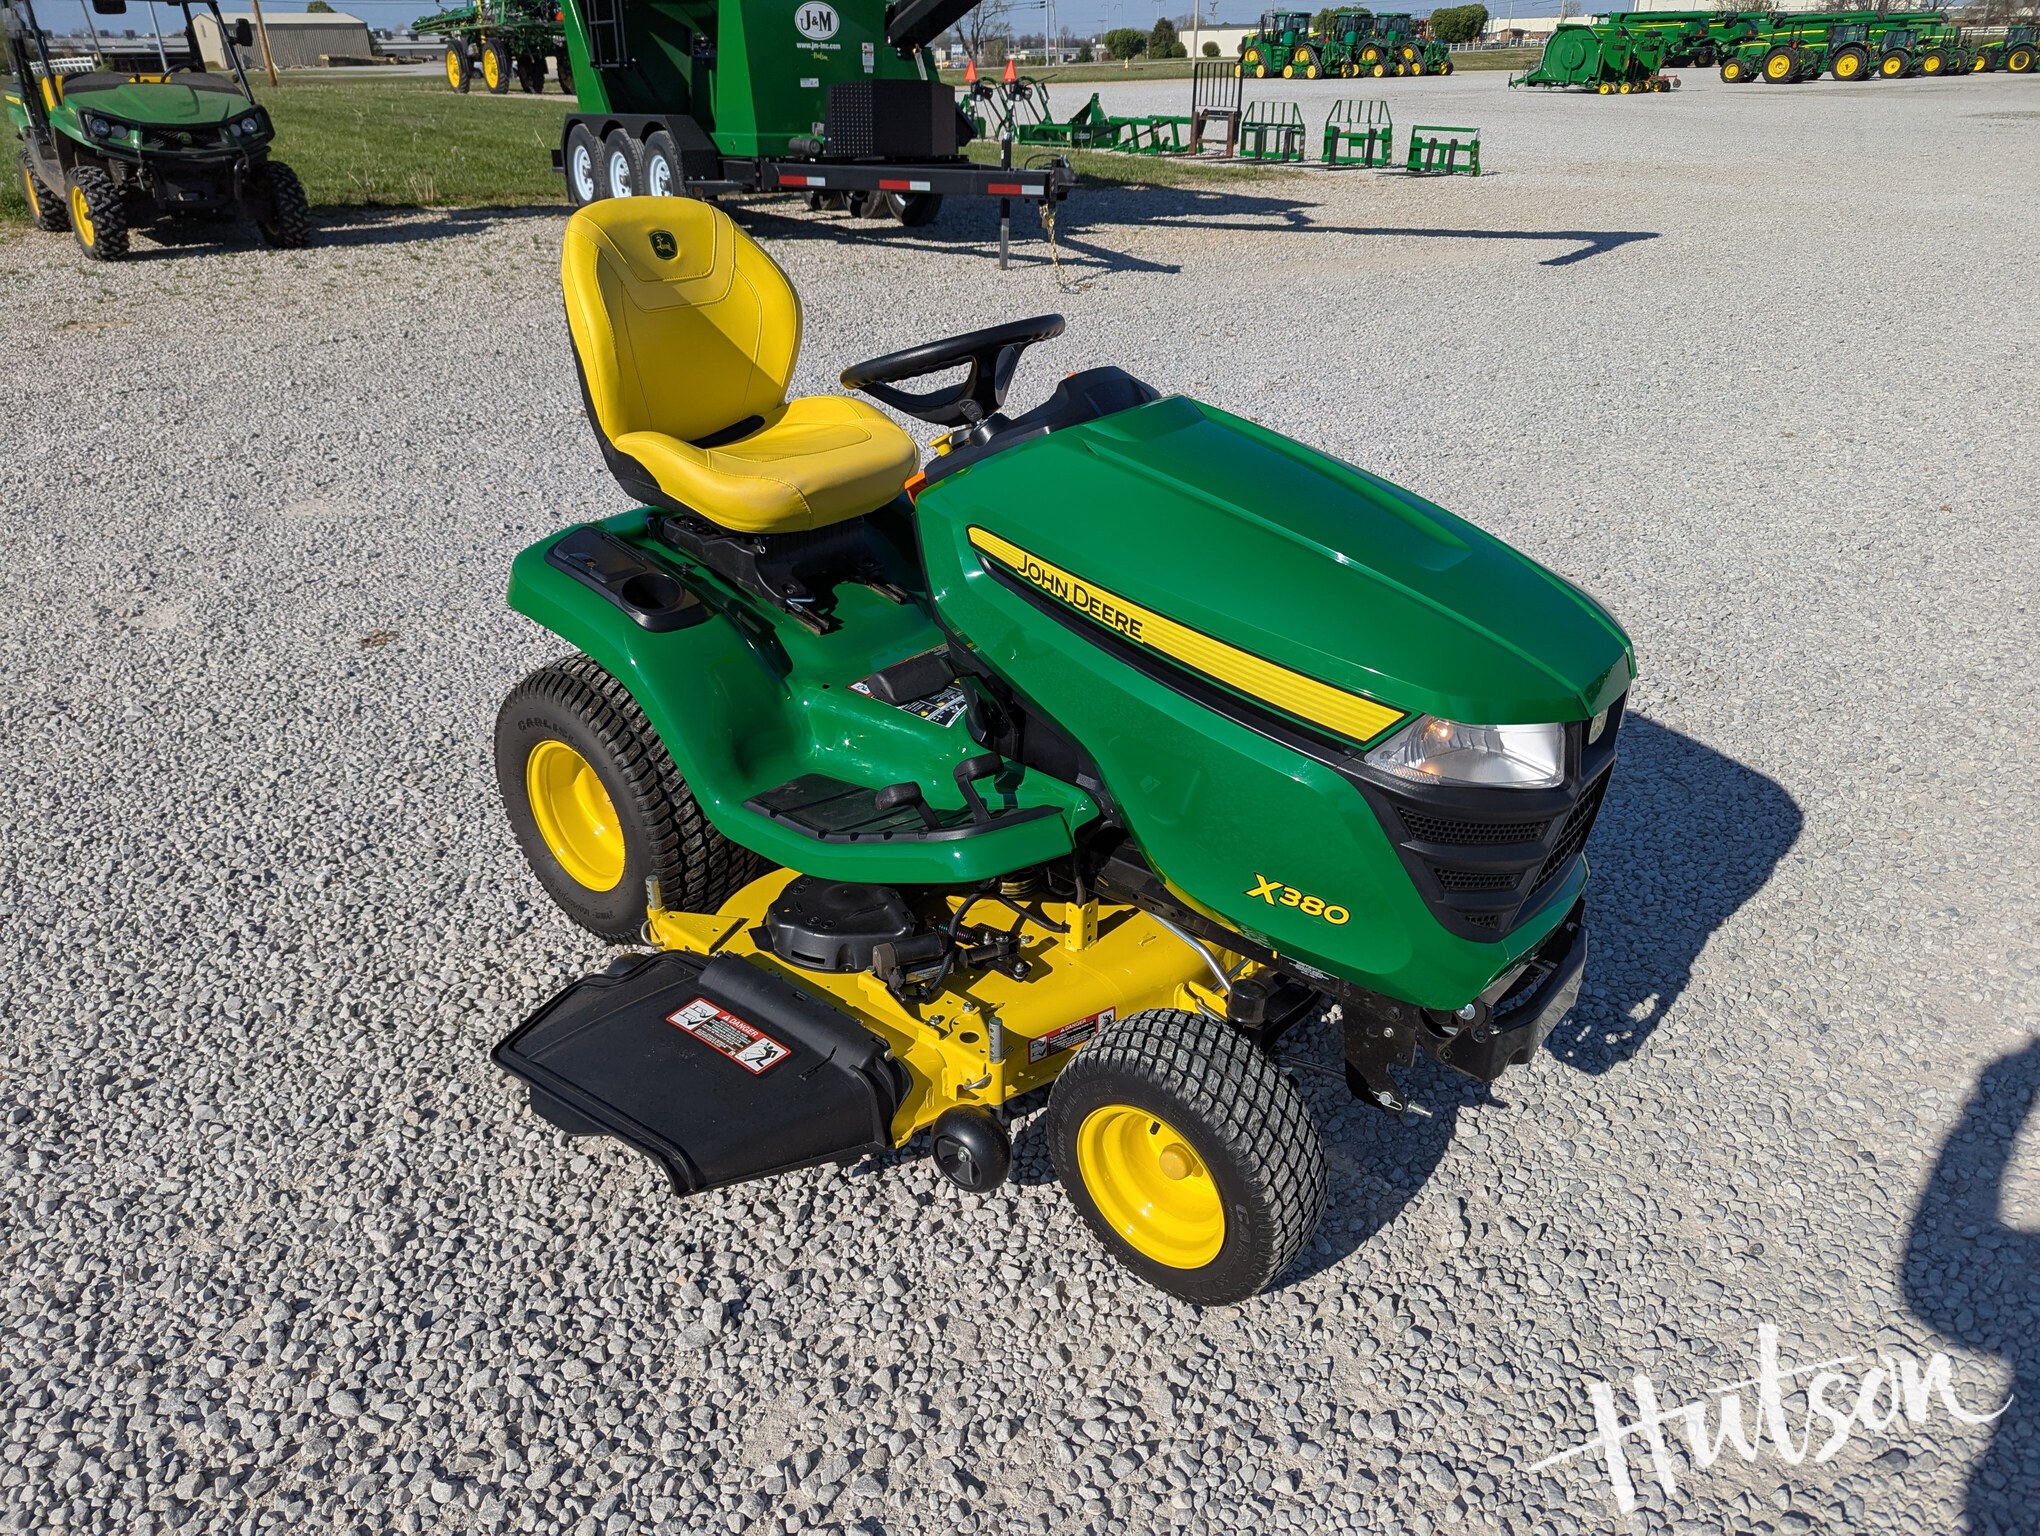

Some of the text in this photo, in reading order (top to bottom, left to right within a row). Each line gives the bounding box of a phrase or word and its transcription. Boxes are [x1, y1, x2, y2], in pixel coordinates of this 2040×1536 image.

[800, 10, 833, 32] J&M
[1017, 554, 1143, 640] JOHN DEERE
[1243, 871, 1351, 926] X380
[729, 1018, 759, 1037] DANGER
[1065, 1018, 1087, 1032] DANGER
